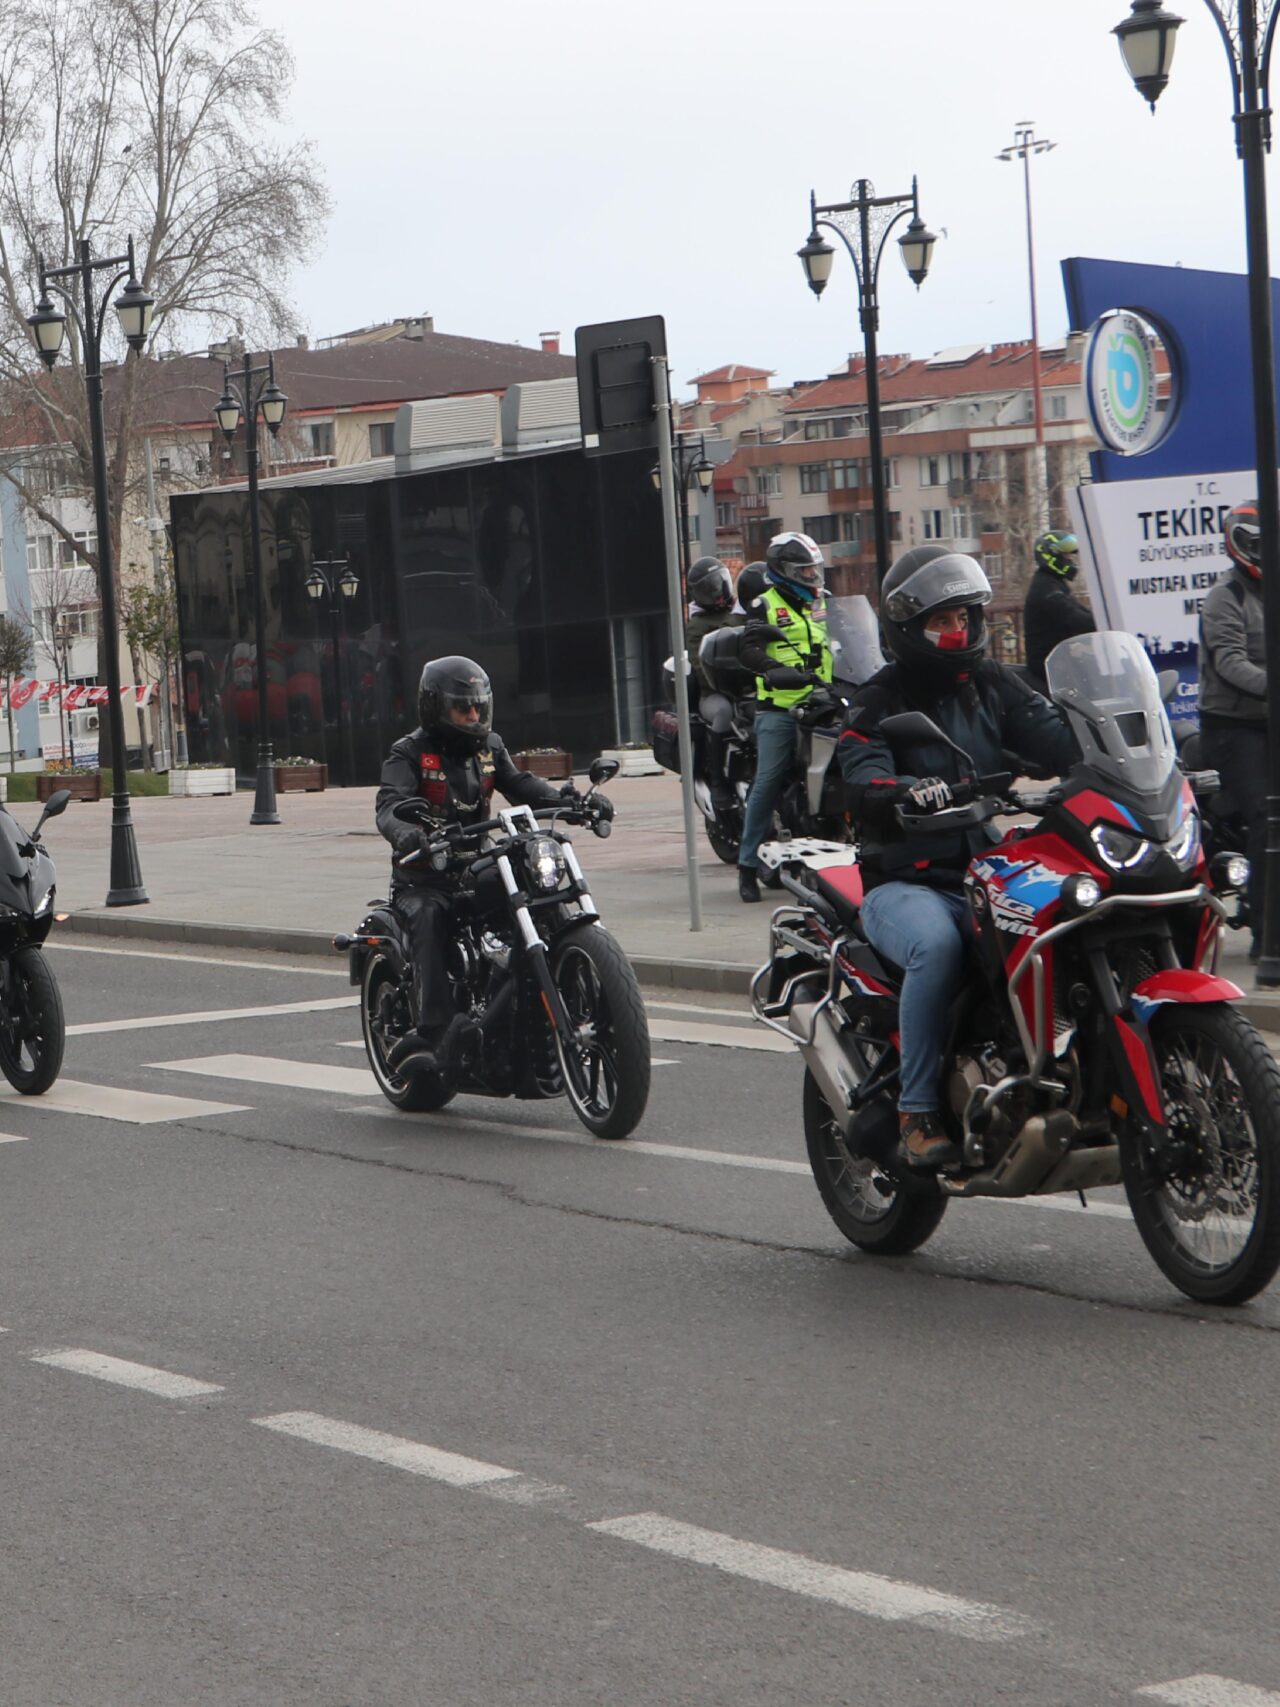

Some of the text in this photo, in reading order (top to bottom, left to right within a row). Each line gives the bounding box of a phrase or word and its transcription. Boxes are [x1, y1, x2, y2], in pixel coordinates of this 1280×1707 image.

[1138, 499, 1232, 540] TEKİRD
[1140, 540, 1215, 562] BÜYÜKŞEHİR
[1129, 571, 1219, 595] MUSTAFA KEM
[1184, 598, 1206, 615] ME
